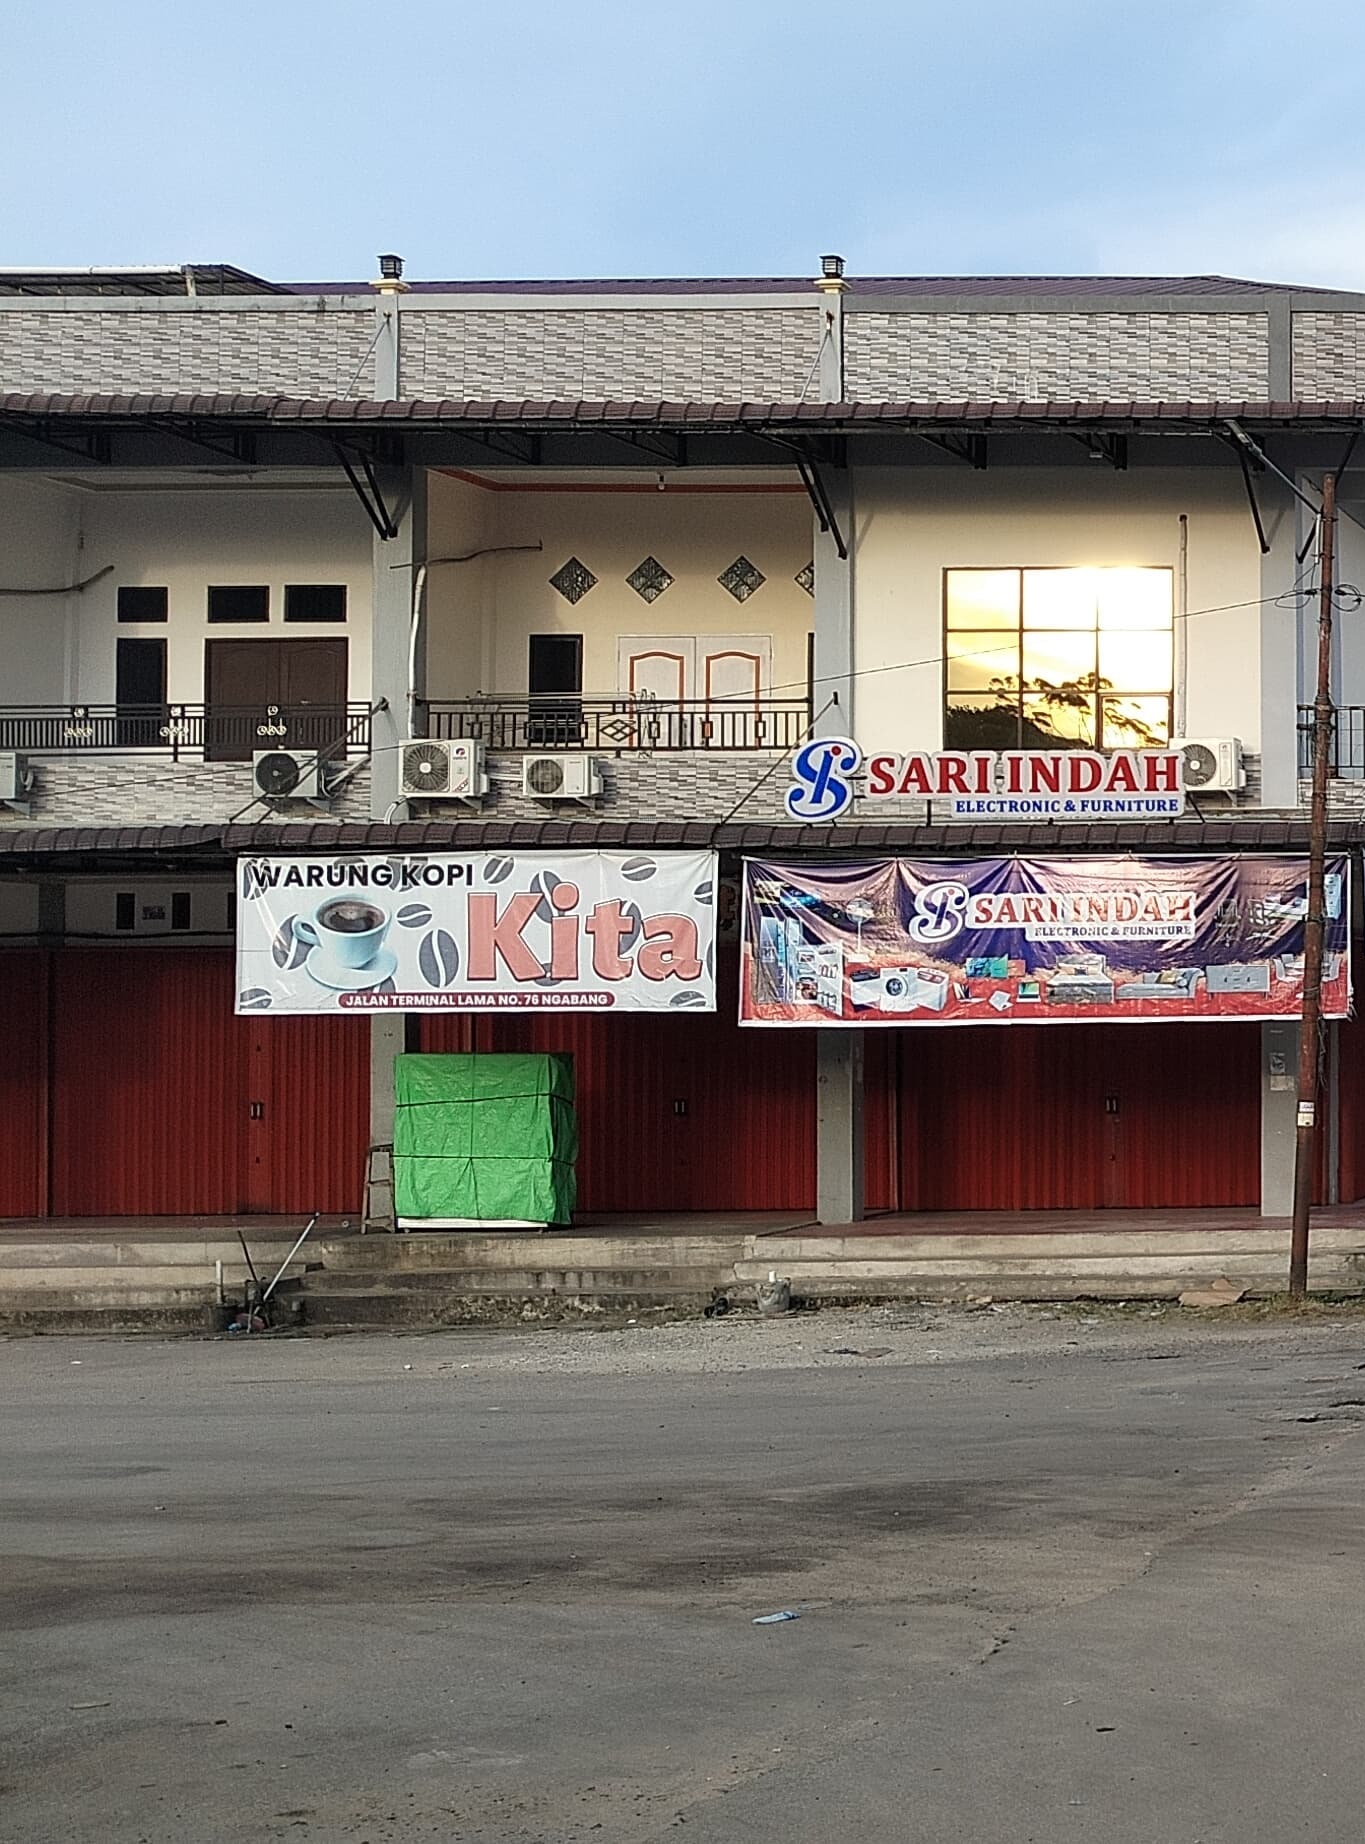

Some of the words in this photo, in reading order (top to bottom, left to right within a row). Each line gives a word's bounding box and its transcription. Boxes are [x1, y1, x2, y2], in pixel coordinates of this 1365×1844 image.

[869, 757, 990, 795] SARI
[1007, 755, 1180, 793] INDAH
[955, 800, 1060, 813] ELECTRONIC
[1063, 799, 1076, 812] &
[1080, 798, 1179, 812] FURNITURE
[254, 864, 393, 888] WARUNG
[402, 863, 474, 887] KOPI
[974, 897, 1066, 924] SARI
[1070, 891, 1192, 923] INDAH
[466, 881, 704, 984] Kita
[1034, 925, 1109, 937] ELECTRONIC
[1110, 925, 1119, 936] &
[1122, 925, 1192, 936] FURNITURE
[345, 993, 388, 1007] JALAN
[388, 993, 456, 1006] TERMINAL
[457, 993, 497, 1006] LAMA
[498, 993, 523, 1006] NO.
[524, 993, 538, 1006] 76
[541, 993, 608, 1006] NGABANG
